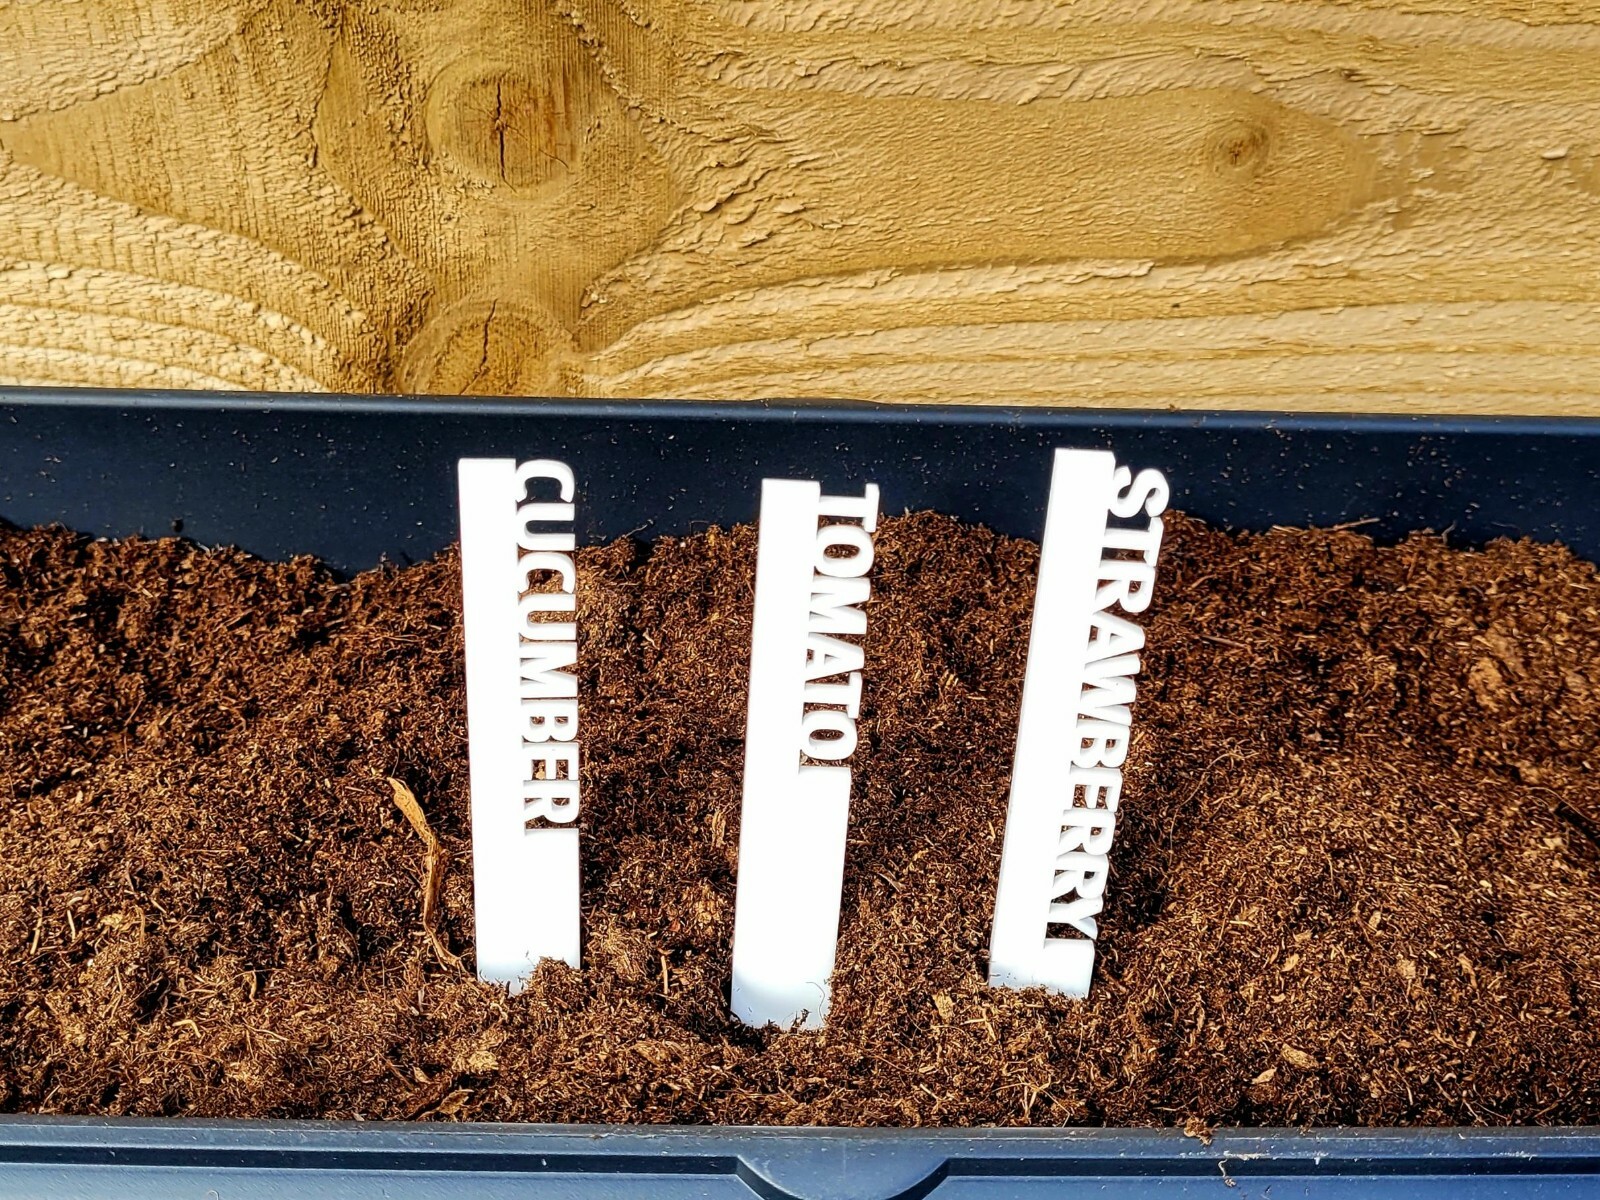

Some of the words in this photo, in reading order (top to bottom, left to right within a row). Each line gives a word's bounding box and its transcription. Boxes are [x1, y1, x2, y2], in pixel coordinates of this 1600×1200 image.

[514, 458, 580, 824] CUCUMBER
[799, 483, 880, 761] TOMATO
[1045, 465, 1170, 940] STRAWBERRY
